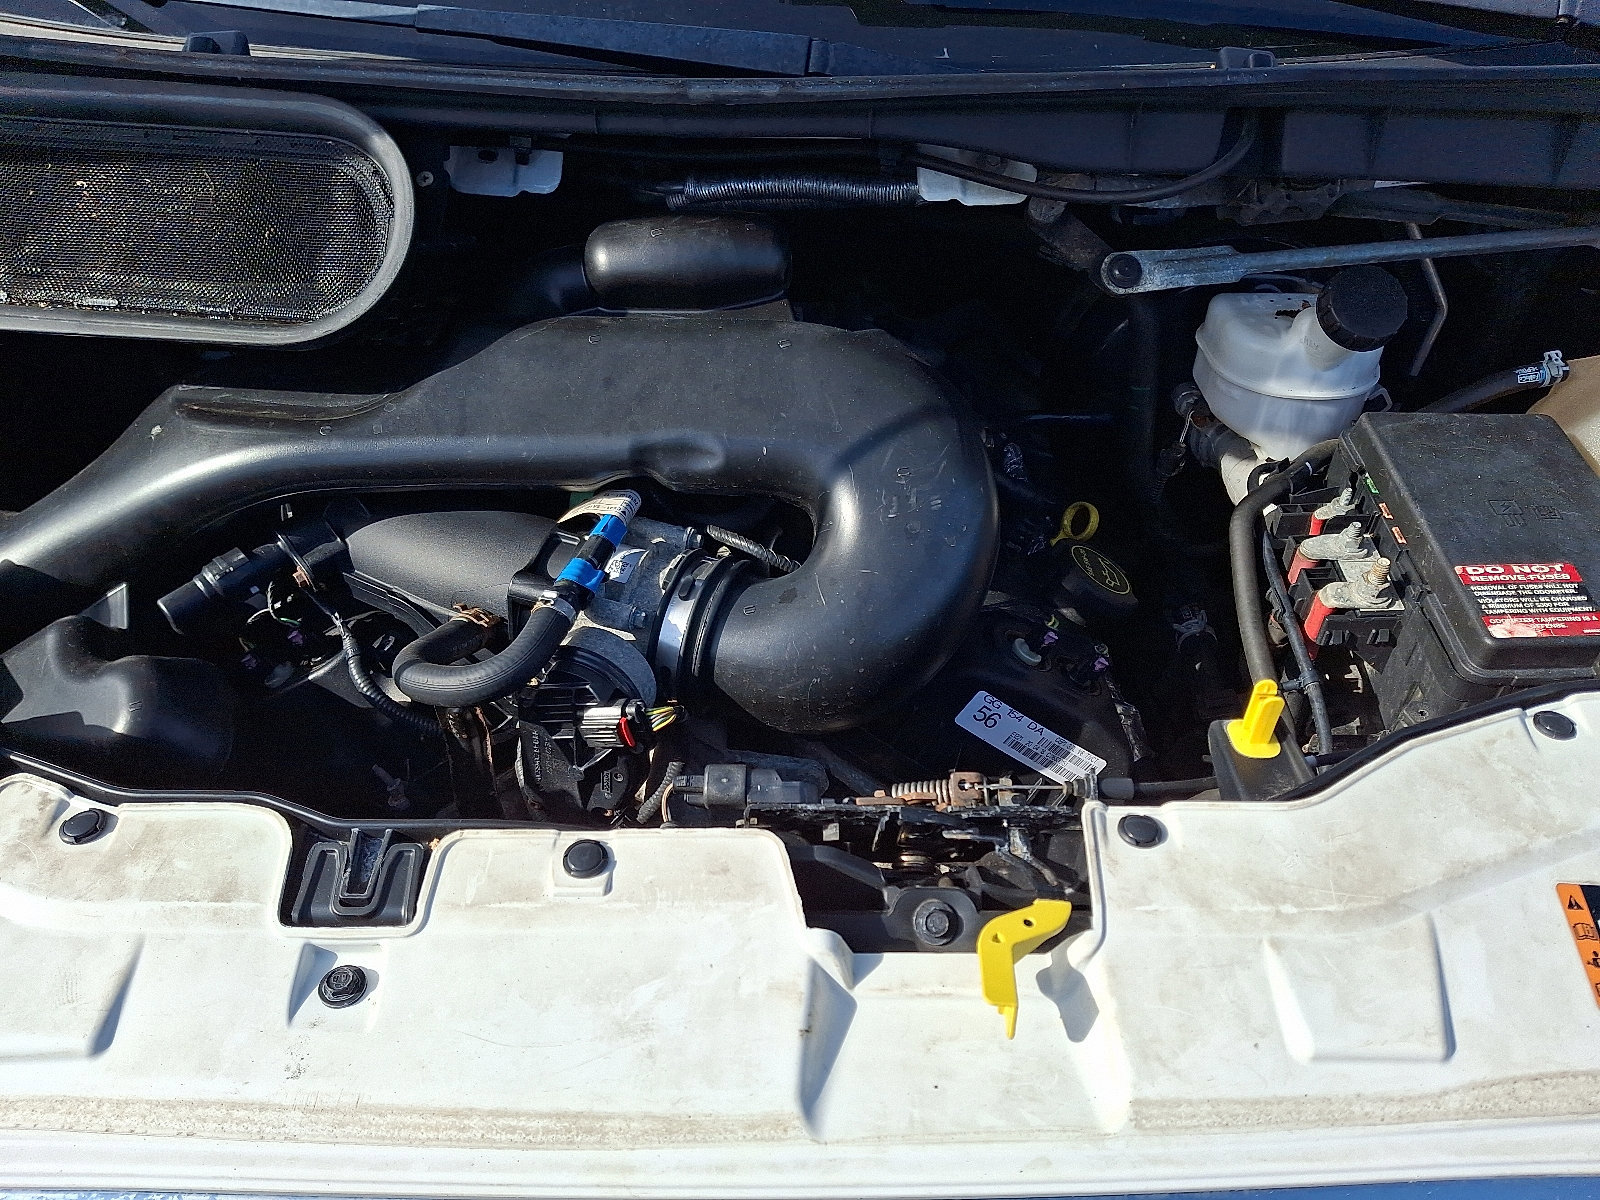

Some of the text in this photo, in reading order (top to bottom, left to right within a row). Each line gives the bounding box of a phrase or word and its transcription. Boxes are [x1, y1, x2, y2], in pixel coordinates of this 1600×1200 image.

[1466, 564, 1564, 575] DO NOT
[973, 705, 1001, 728] 56
[1007, 709, 1024, 722] 154
[1027, 722, 1045, 736] DA
